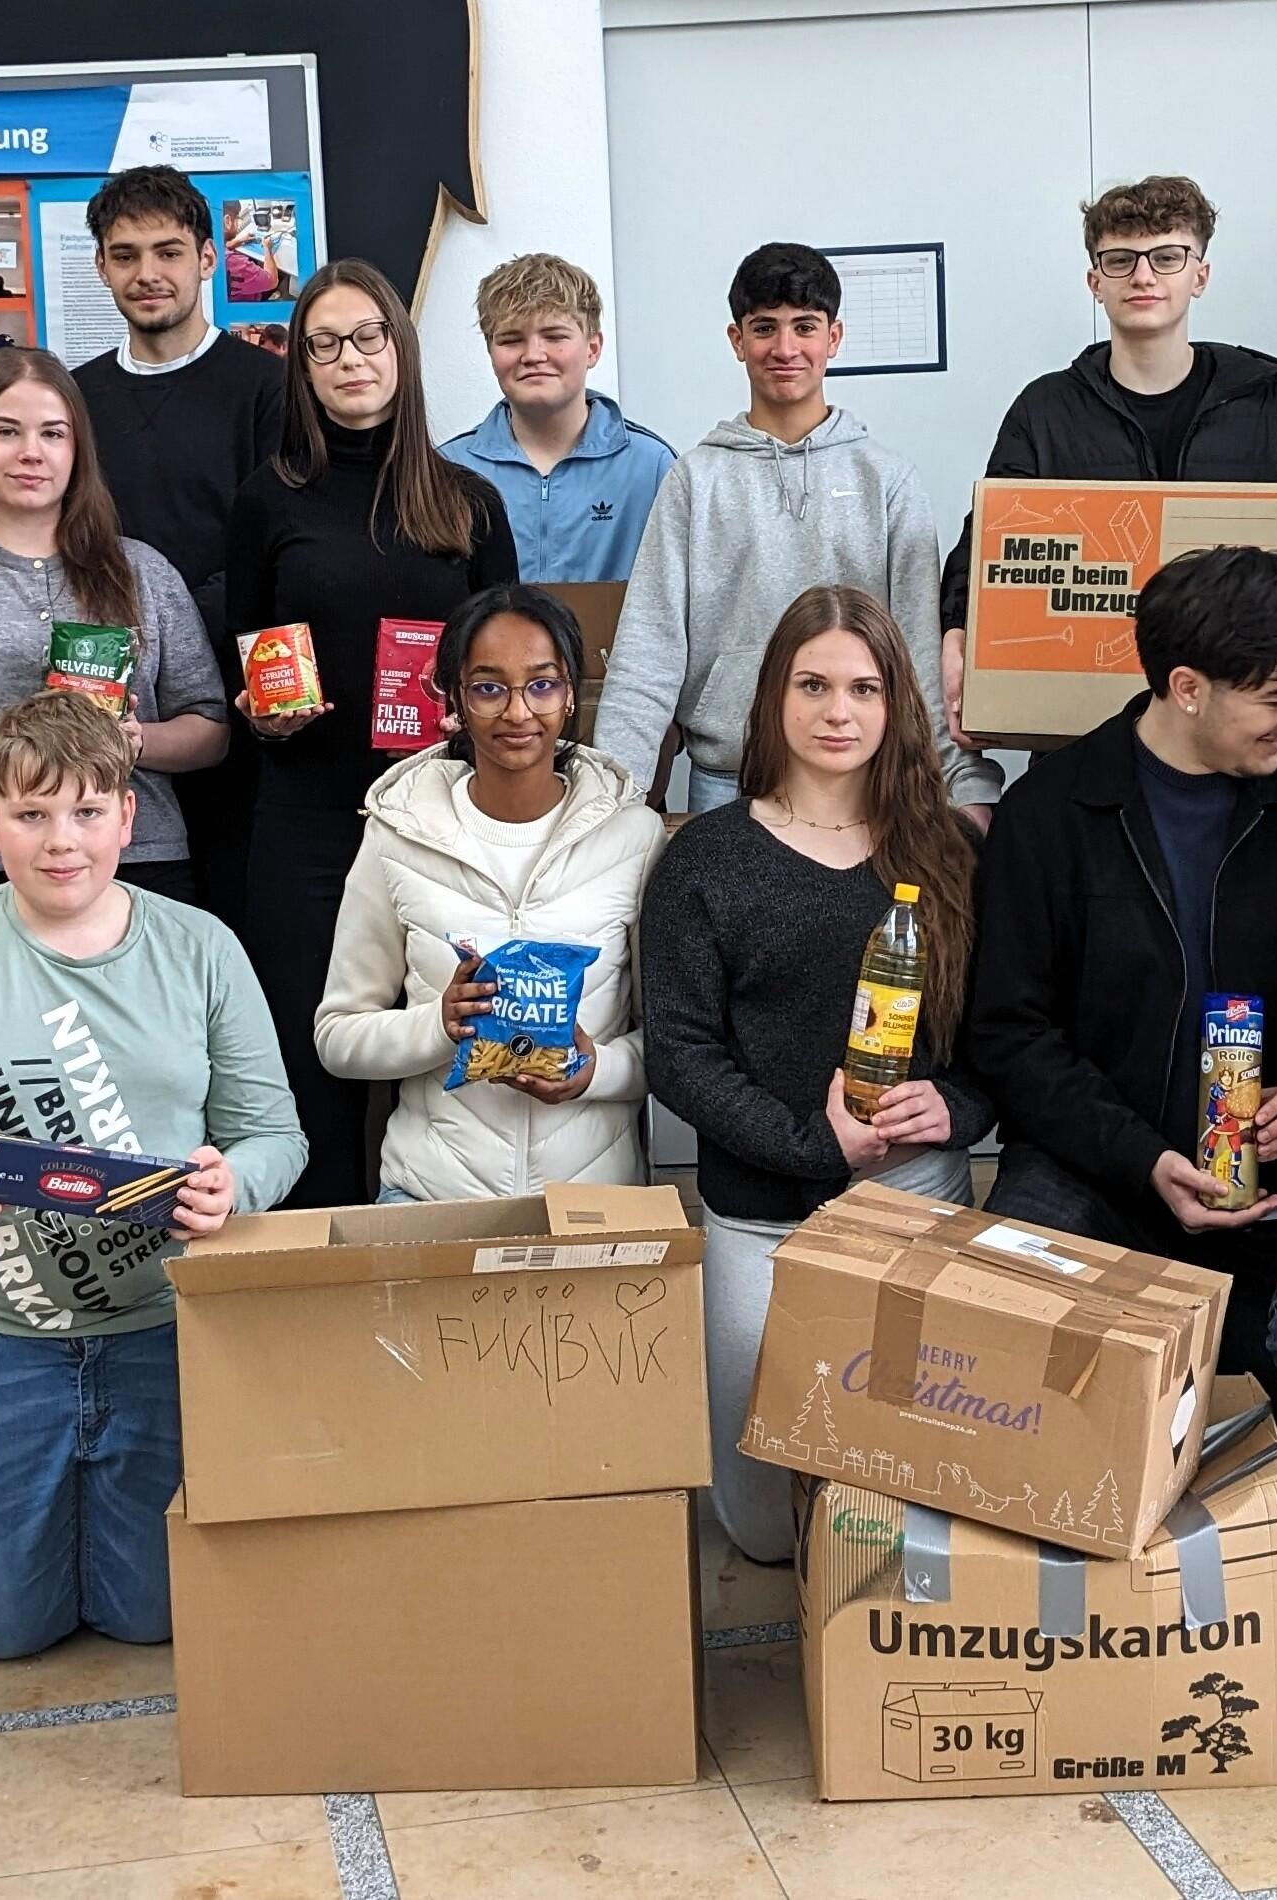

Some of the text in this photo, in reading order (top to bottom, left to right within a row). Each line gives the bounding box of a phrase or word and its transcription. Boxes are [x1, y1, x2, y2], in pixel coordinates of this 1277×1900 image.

[1004, 537, 1079, 561] Mehr
[988, 563, 1128, 586] Freude beim
[395, 631, 436, 642] EDUSCHO
[378, 704, 419, 720] FILTER
[376, 719, 421, 735] KAFFEE
[491, 996, 568, 1024] RIGATE
[1209, 1022, 1262, 1046] Prinzen
[1219, 1051, 1253, 1061] Rolle
[40, 1161, 109, 1181] COLLEZIONE
[47, 1177, 96, 1195] Barilla
[868, 1608, 1261, 1671] Umzugskarton
[932, 1722, 1025, 1755] 30 kg
[1053, 1754, 1186, 1779] Größe M
